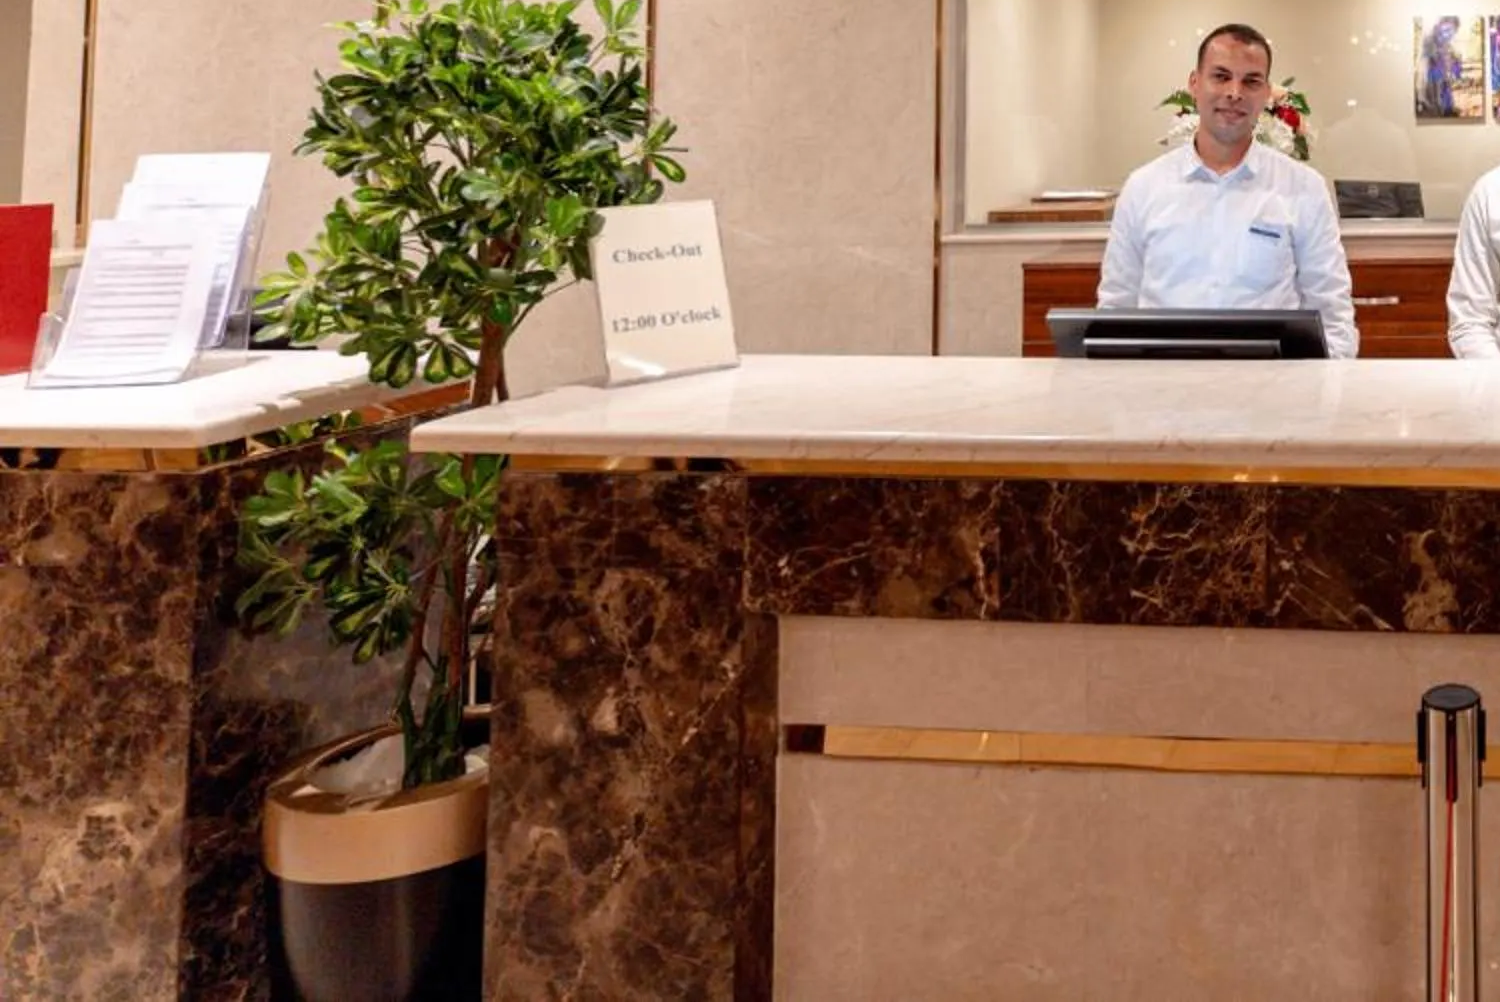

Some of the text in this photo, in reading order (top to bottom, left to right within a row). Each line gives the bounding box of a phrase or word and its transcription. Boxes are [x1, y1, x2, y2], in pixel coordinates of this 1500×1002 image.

[612, 243, 703, 264] Check-Out
[611, 305, 721, 333] 12:00 O'clock
